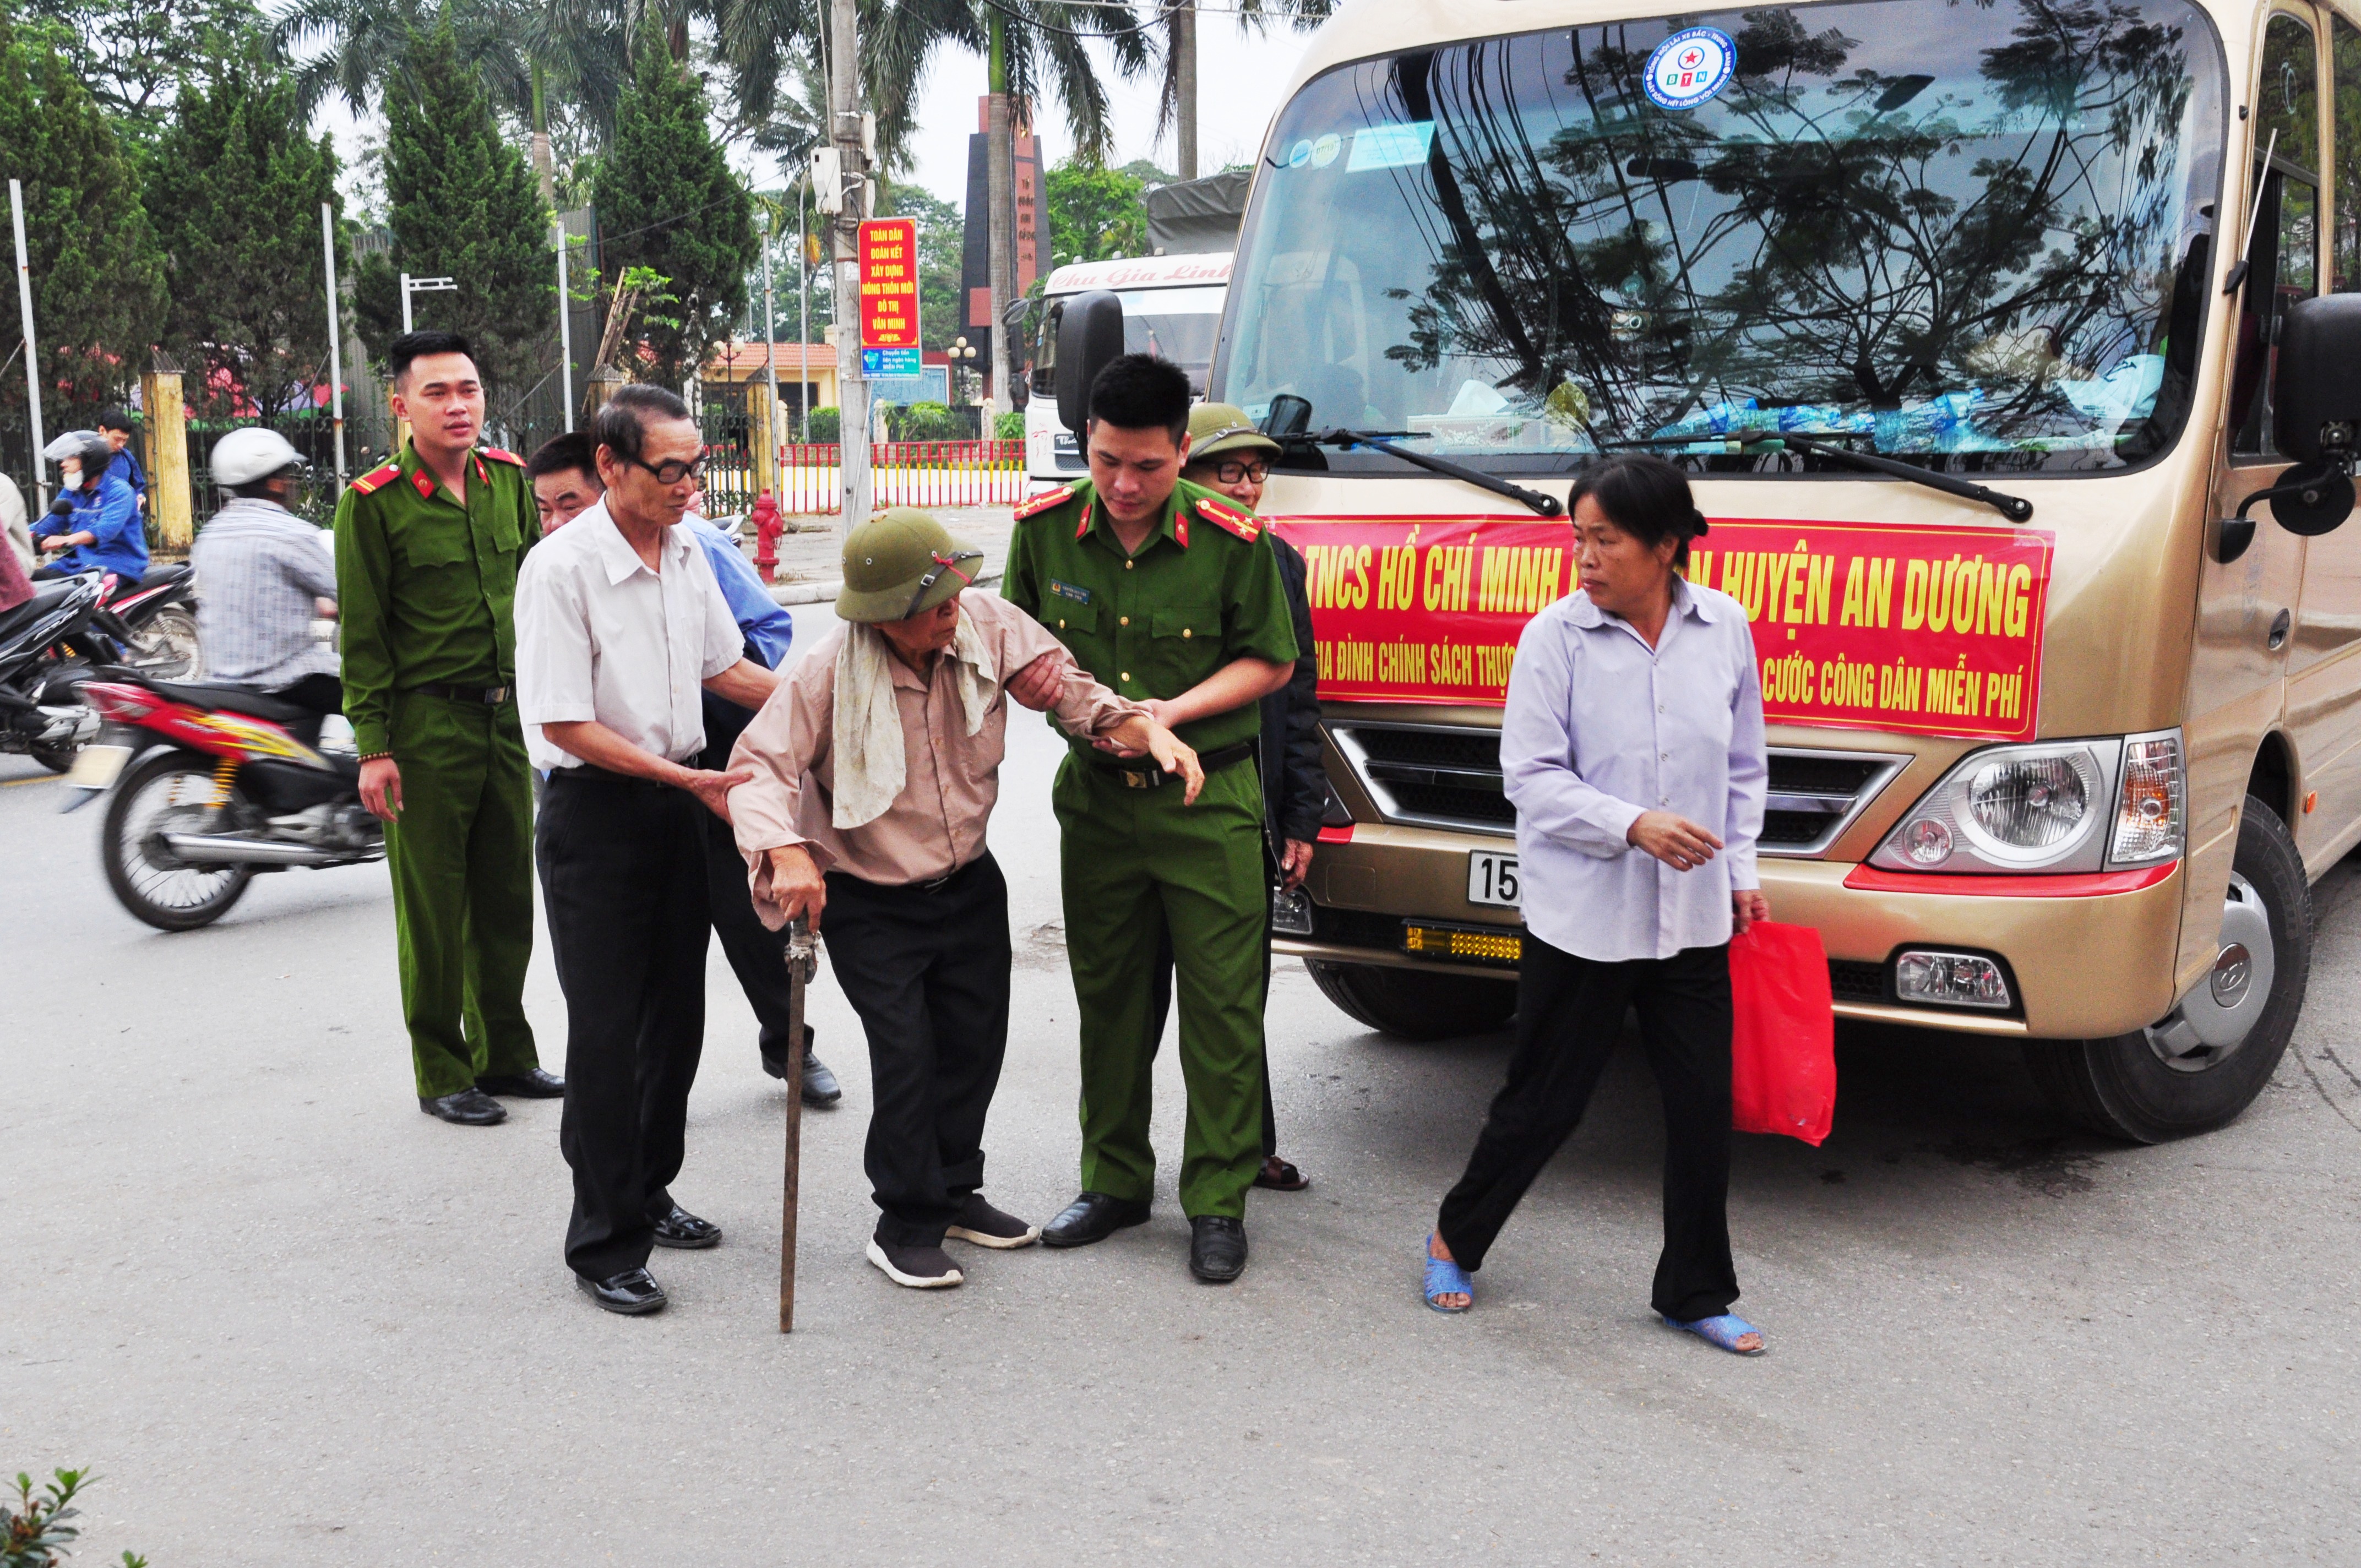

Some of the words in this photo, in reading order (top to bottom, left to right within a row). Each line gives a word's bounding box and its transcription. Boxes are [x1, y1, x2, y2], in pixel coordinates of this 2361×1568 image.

[1711, 33, 1727, 48] TRUNG
[870, 228, 887, 242] TOÀN
[889, 227, 902, 241] DÂN
[871, 246, 889, 259] ĐOÀN
[890, 244, 902, 259] KẾT
[871, 264, 884, 277] XÂY
[885, 264, 904, 279] DỰNG
[1053, 273, 1097, 288] Chu
[1102, 268, 1157, 287] Gia
[862, 282, 880, 295] NÔNG
[882, 281, 899, 295] THÔN
[900, 280, 914, 294] MỚI
[878, 298, 887, 312] ĐÔ
[888, 300, 899, 314] THỊ
[872, 316, 886, 330] VĂN
[887, 318, 905, 330] MINH
[1305, 545, 1371, 609] TNCS
[1378, 524, 1420, 611] HỒ
[1423, 533, 1477, 611] CHÍ
[1479, 546, 1563, 613] MINH
[1722, 538, 1835, 640] HUYỆN
[1840, 557, 1895, 628] AN
[1902, 553, 2031, 638] DƯƠNG
[1337, 633, 1373, 682] ĐÌNH
[1378, 634, 1426, 684] CHÍNH
[1430, 635, 1473, 686] SÁCH
[1762, 649, 1815, 704] CƯỚC
[1820, 652, 1874, 709] CÔNG
[1879, 656, 1922, 712] DÂN
[1925, 652, 1982, 716] MIỄN
[1985, 665, 2024, 720] PHÍ
